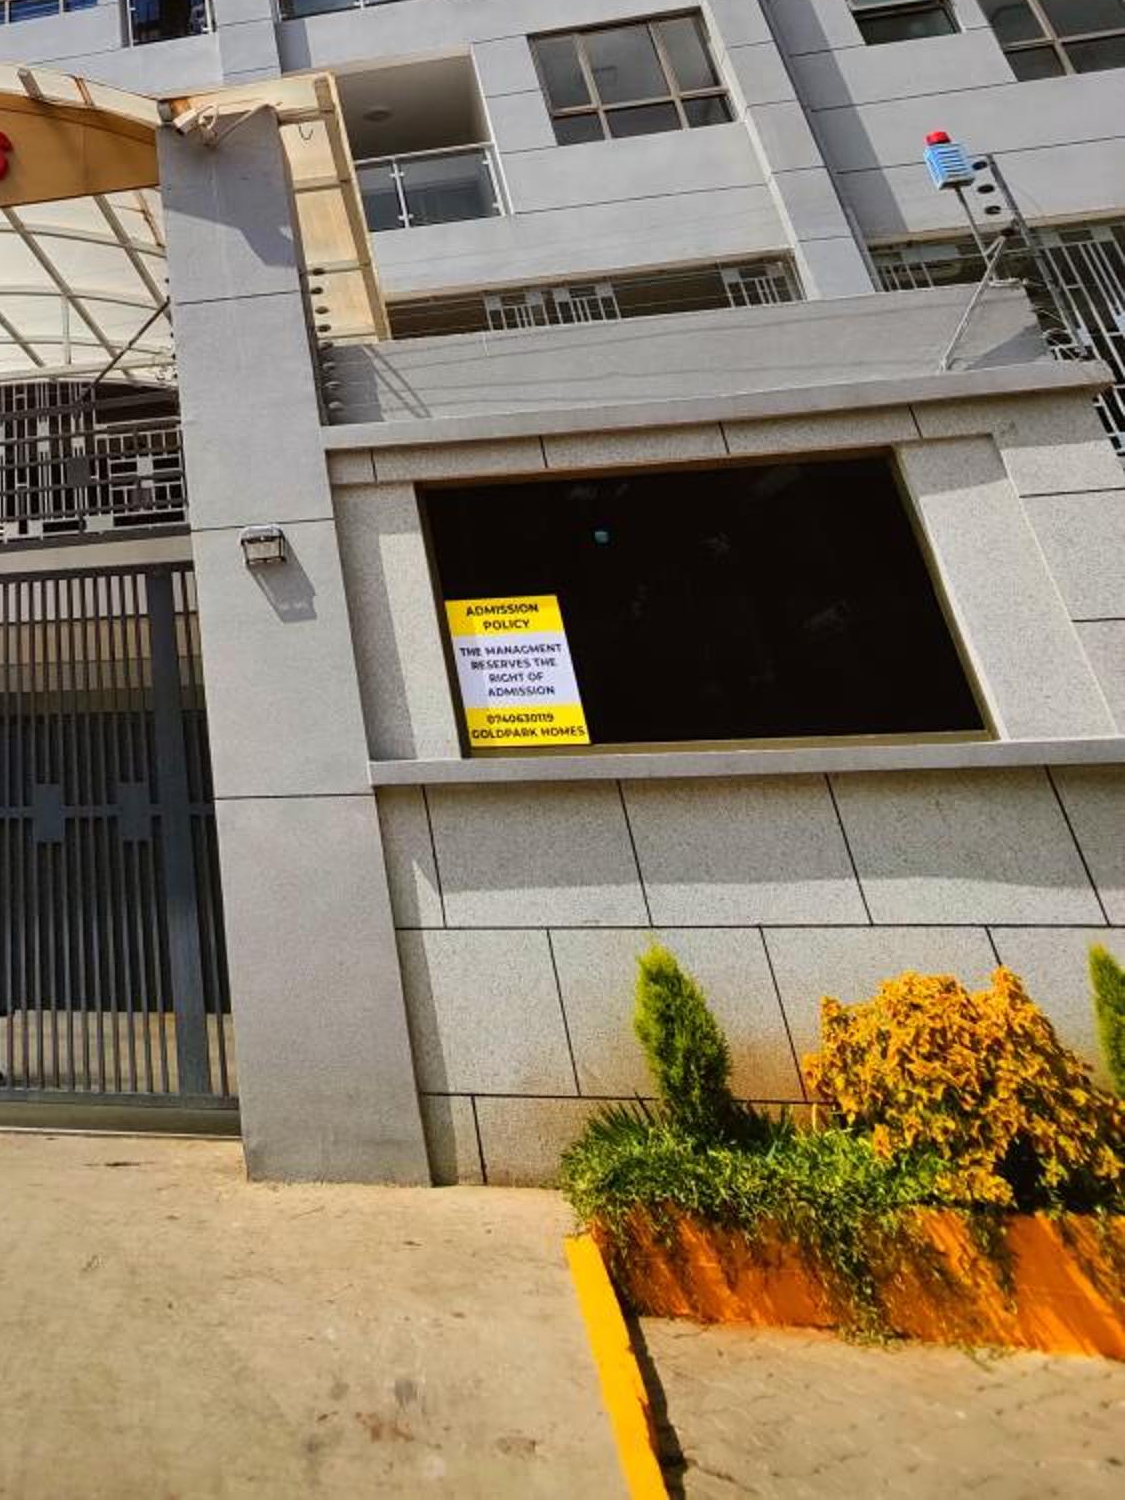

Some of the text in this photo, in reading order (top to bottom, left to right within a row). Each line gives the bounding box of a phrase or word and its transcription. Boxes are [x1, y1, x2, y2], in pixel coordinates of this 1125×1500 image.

[466, 603, 539, 617] ADMISSION
[483, 619, 530, 631] POLICY
[459, 643, 561, 657] THE MANAGMENT
[471, 657, 556, 670] RESERVES THE
[488, 671, 544, 683] RIGHT OF
[488, 685, 555, 697] ADMISSION
[472, 725, 586, 739] GOLDPARK HOMES
